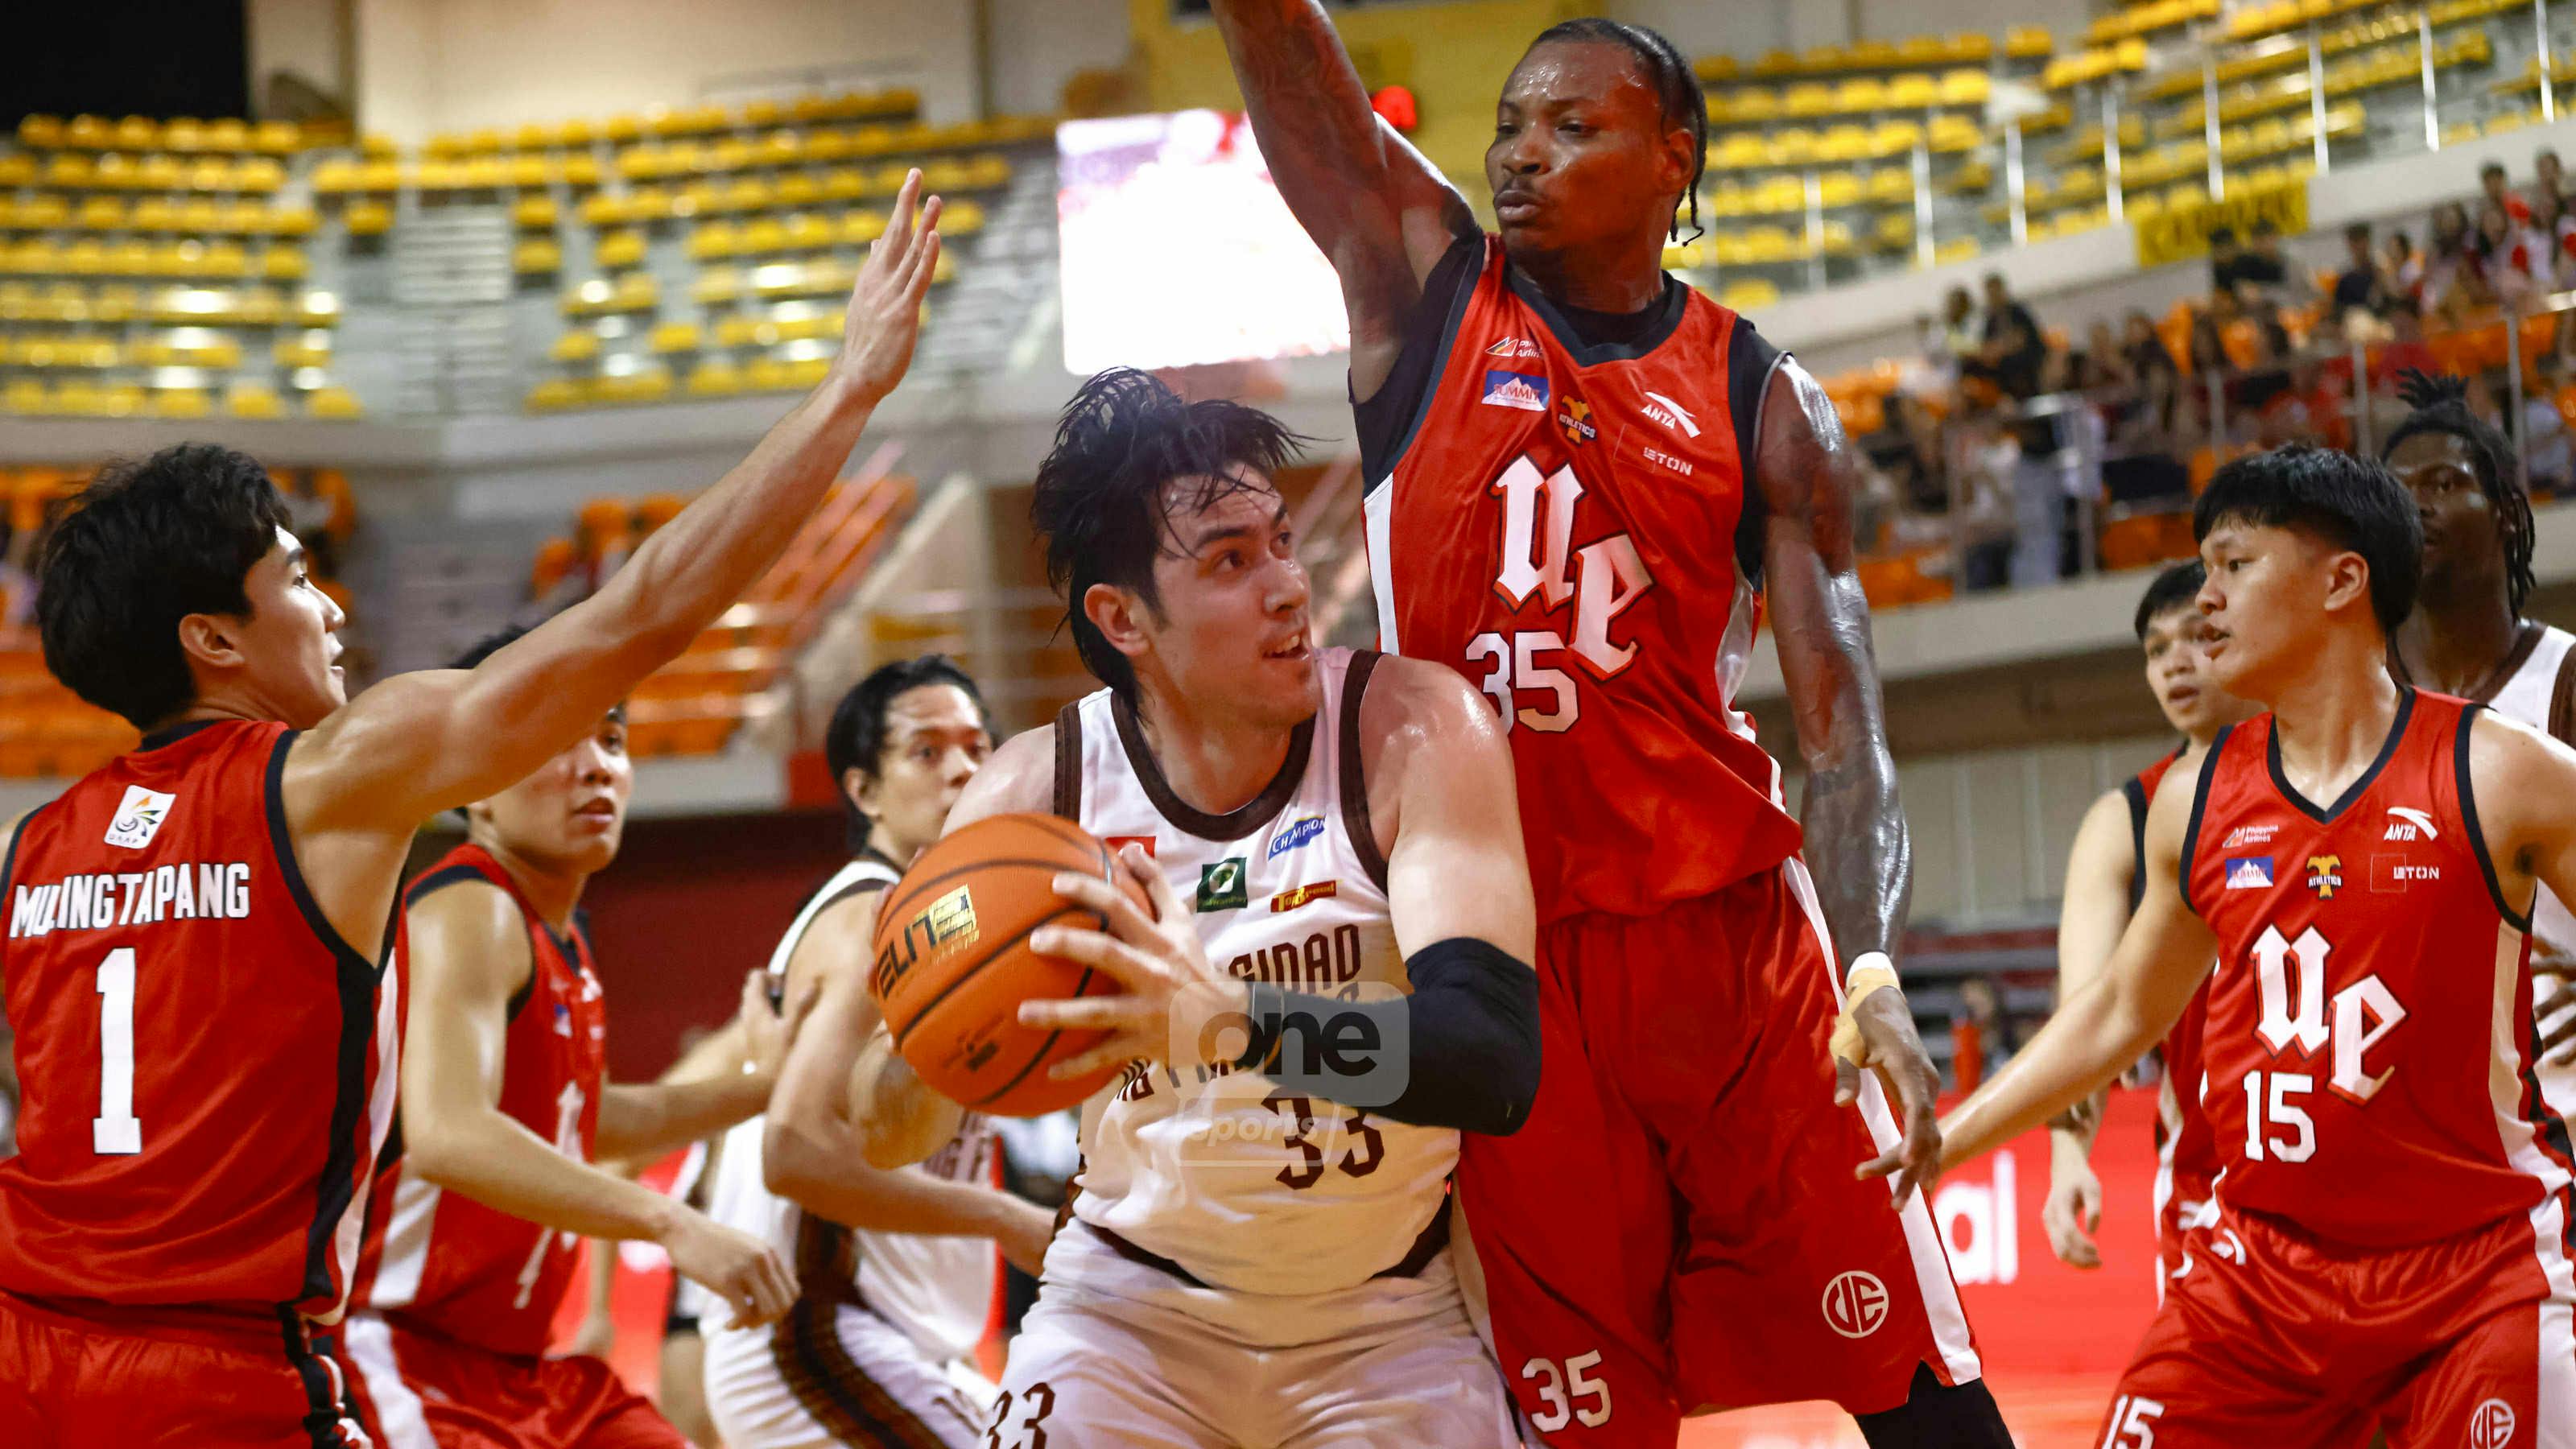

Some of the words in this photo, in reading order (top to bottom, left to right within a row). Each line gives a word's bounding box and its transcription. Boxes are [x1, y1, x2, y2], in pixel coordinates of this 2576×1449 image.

[1641, 405, 1677, 430] ANTA
[1465, 631, 1579, 733] 35
[2384, 824, 2416, 841] ANTA
[93, 947, 142, 1154] 1
[1261, 1085, 1385, 1190] 33
[2243, 1069, 2317, 1163] 15
[1521, 1348, 1612, 1433] 35
[2103, 1394, 2166, 1449] 15
